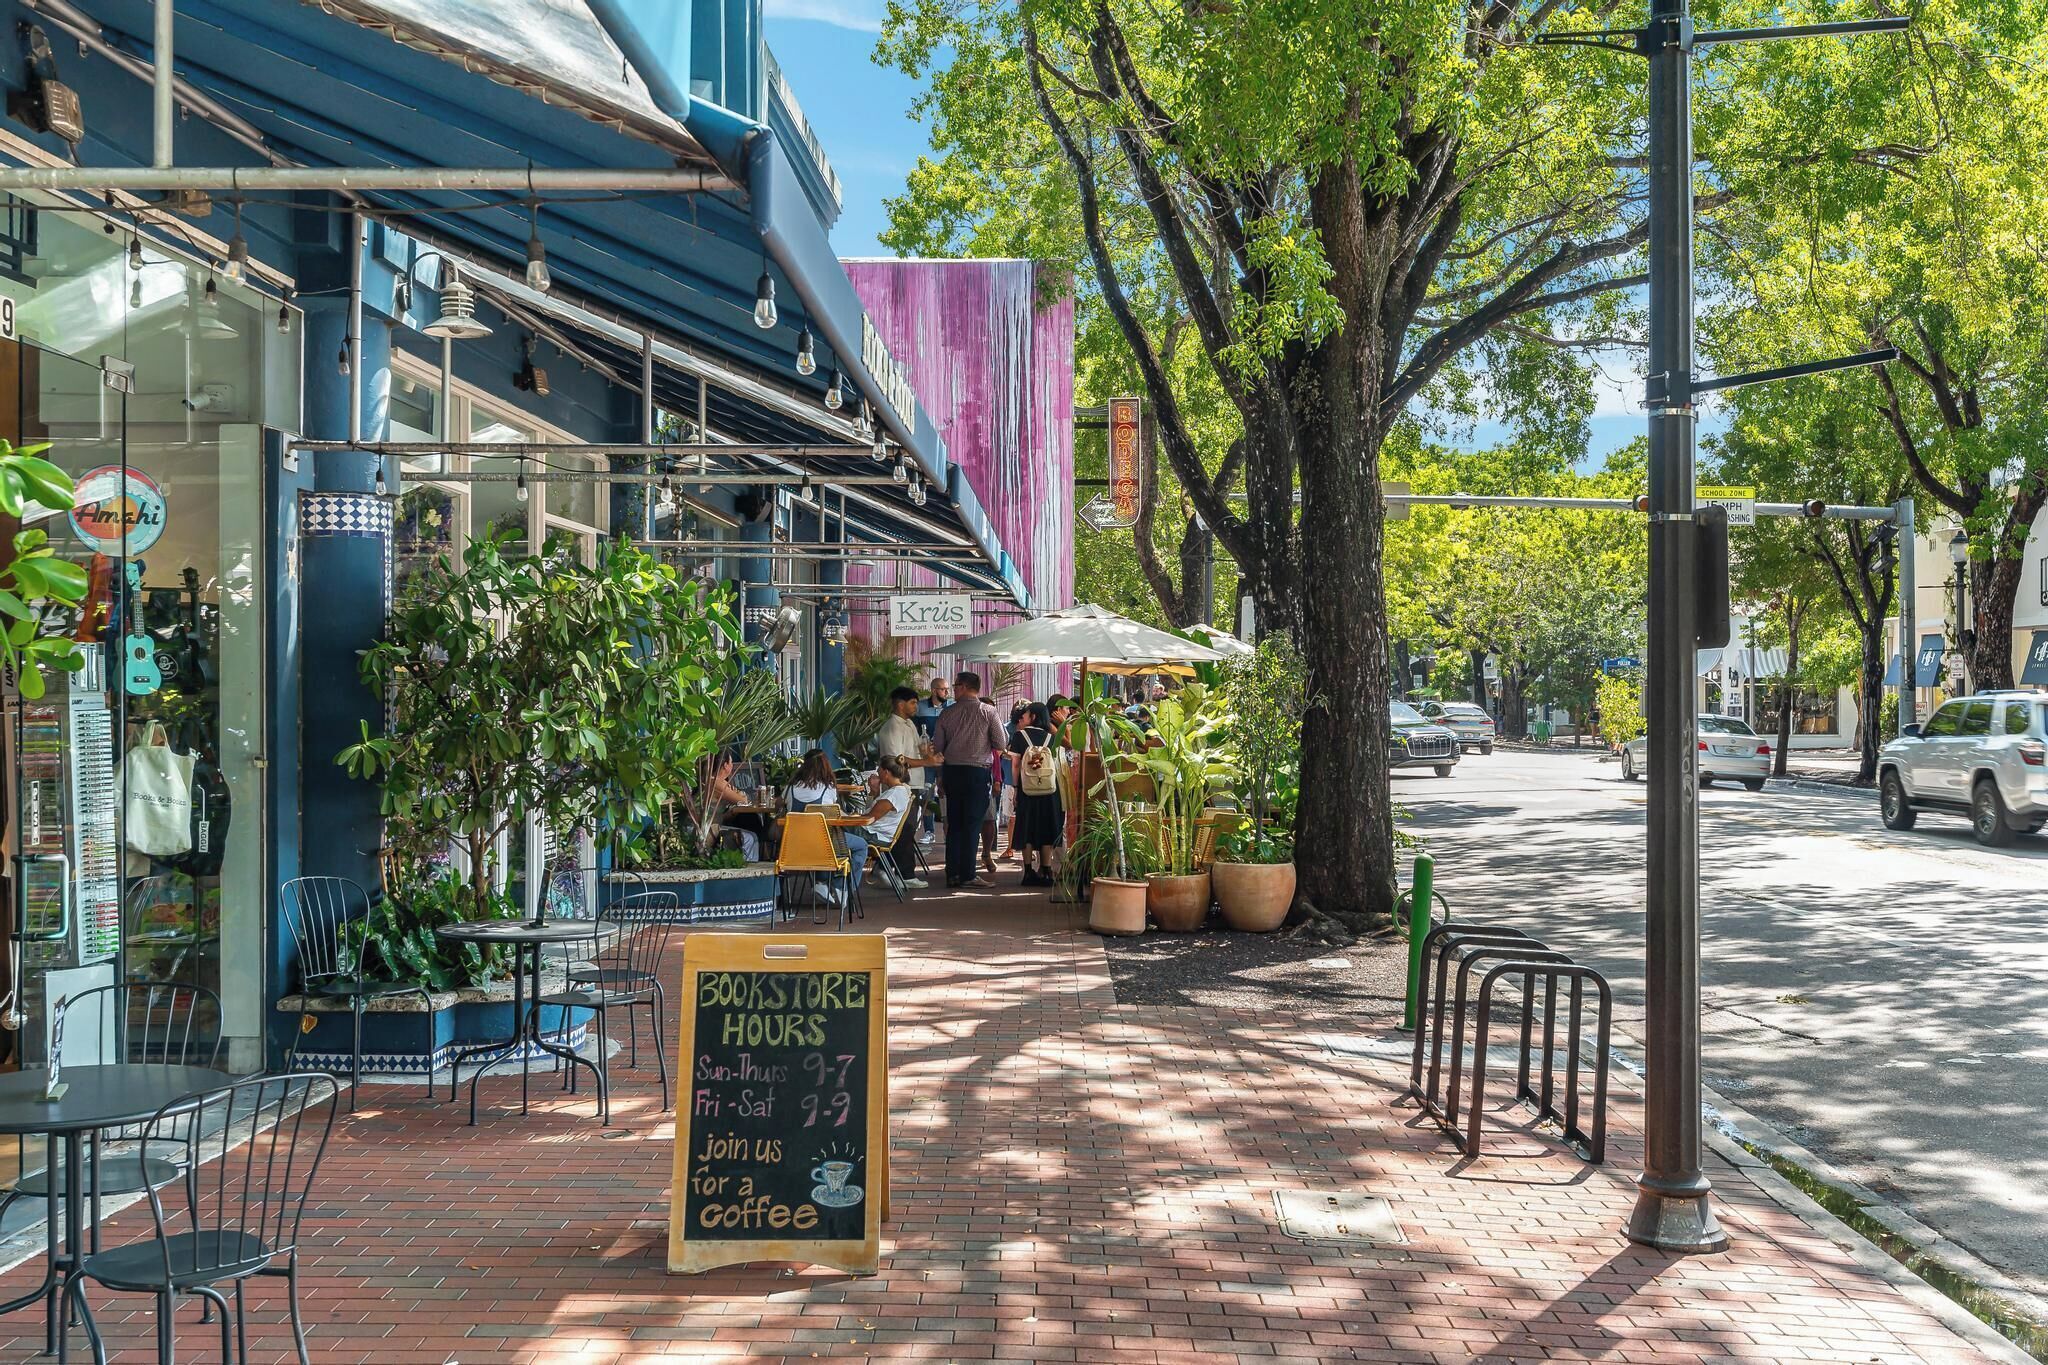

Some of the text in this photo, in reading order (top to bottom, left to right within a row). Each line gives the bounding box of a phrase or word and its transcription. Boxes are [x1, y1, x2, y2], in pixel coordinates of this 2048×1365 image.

[1116, 405, 1135, 515] BODEGA
[1701, 489, 1747, 497] SCHOOL ZONE
[1722, 502, 1742, 511] MPH
[896, 601, 964, 623] Krüs
[950, 622, 967, 630] Store
[700, 973, 868, 1010] BOOKSTORE
[722, 1013, 828, 1047] HOURS
[803, 1052, 857, 1089] 9-7
[698, 1131, 783, 1164] join us
[690, 1165, 753, 1196] for a
[700, 1195, 819, 1230] coffee
